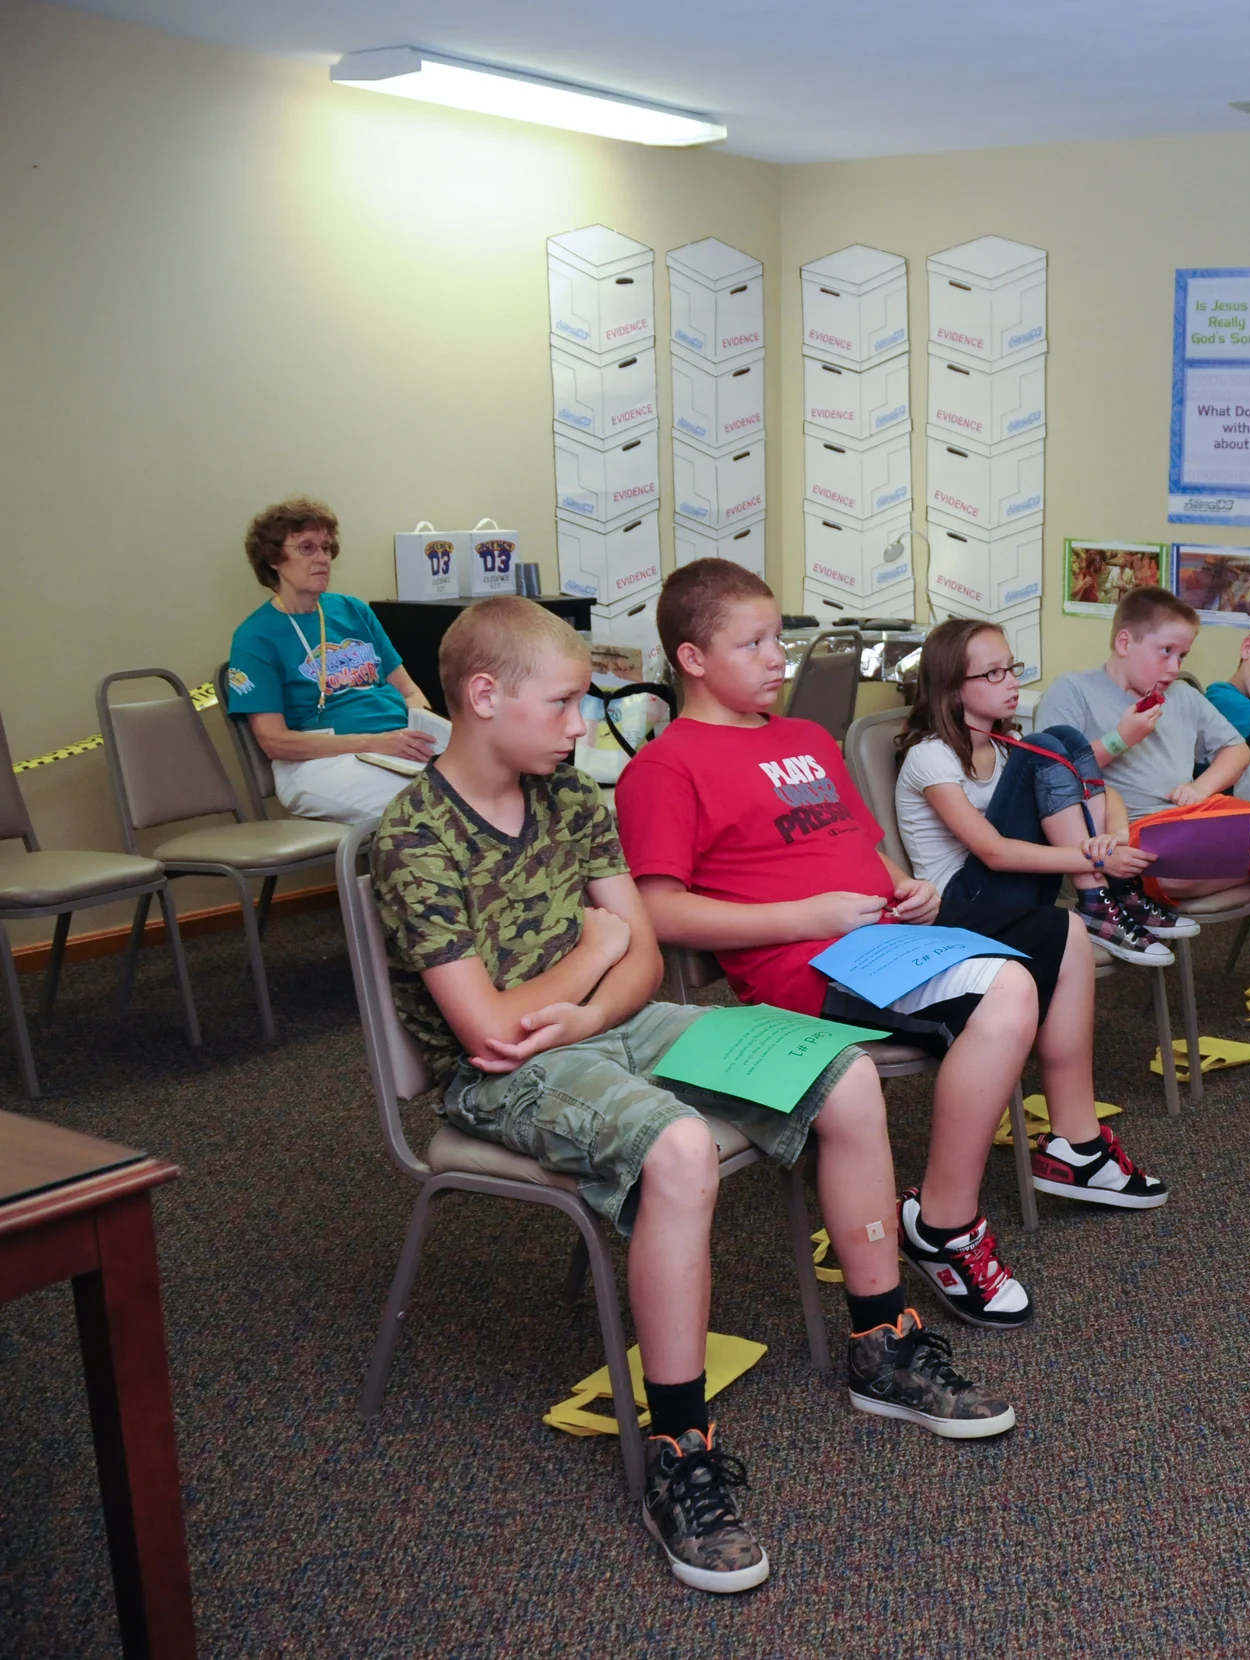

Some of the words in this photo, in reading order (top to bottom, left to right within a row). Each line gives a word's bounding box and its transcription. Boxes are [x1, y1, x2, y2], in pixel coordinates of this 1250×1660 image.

[1195, 300, 1207, 311] Is
[1211, 300, 1248, 312] Jesus
[606, 318, 648, 341] EVIDENCE
[1208, 316, 1246, 330] Really
[722, 332, 759, 349] EVIDENCE
[809, 329, 852, 350] EVIDENCE
[938, 328, 984, 349] EVIDENCE
[1191, 331, 1225, 344] God's
[611, 404, 653, 426] EVIDENCE
[811, 408, 854, 421] EVIDENCE
[936, 409, 983, 432] EVIDENCE
[1198, 405, 1230, 417] What
[725, 413, 761, 433] EVIDENCE
[1222, 423, 1250, 434] with
[1213, 439, 1249, 450] about
[613, 482, 655, 502] EVIDENCE
[812, 484, 855, 508] EVIDENCE
[726, 495, 761, 519] EVIDENCE
[934, 490, 979, 517] EVIDENCE
[428, 550, 450, 576] D3
[480, 550, 511, 573] D3
[616, 565, 657, 589] EVIDENCE
[813, 563, 855, 586] EVIDENCE
[937, 575, 981, 601] EVIDENCE
[758, 755, 826, 788] PLAYS
[934, 944, 965, 955] Card
[804, 1031, 832, 1044] Card
[788, 1045, 808, 1057] #1
